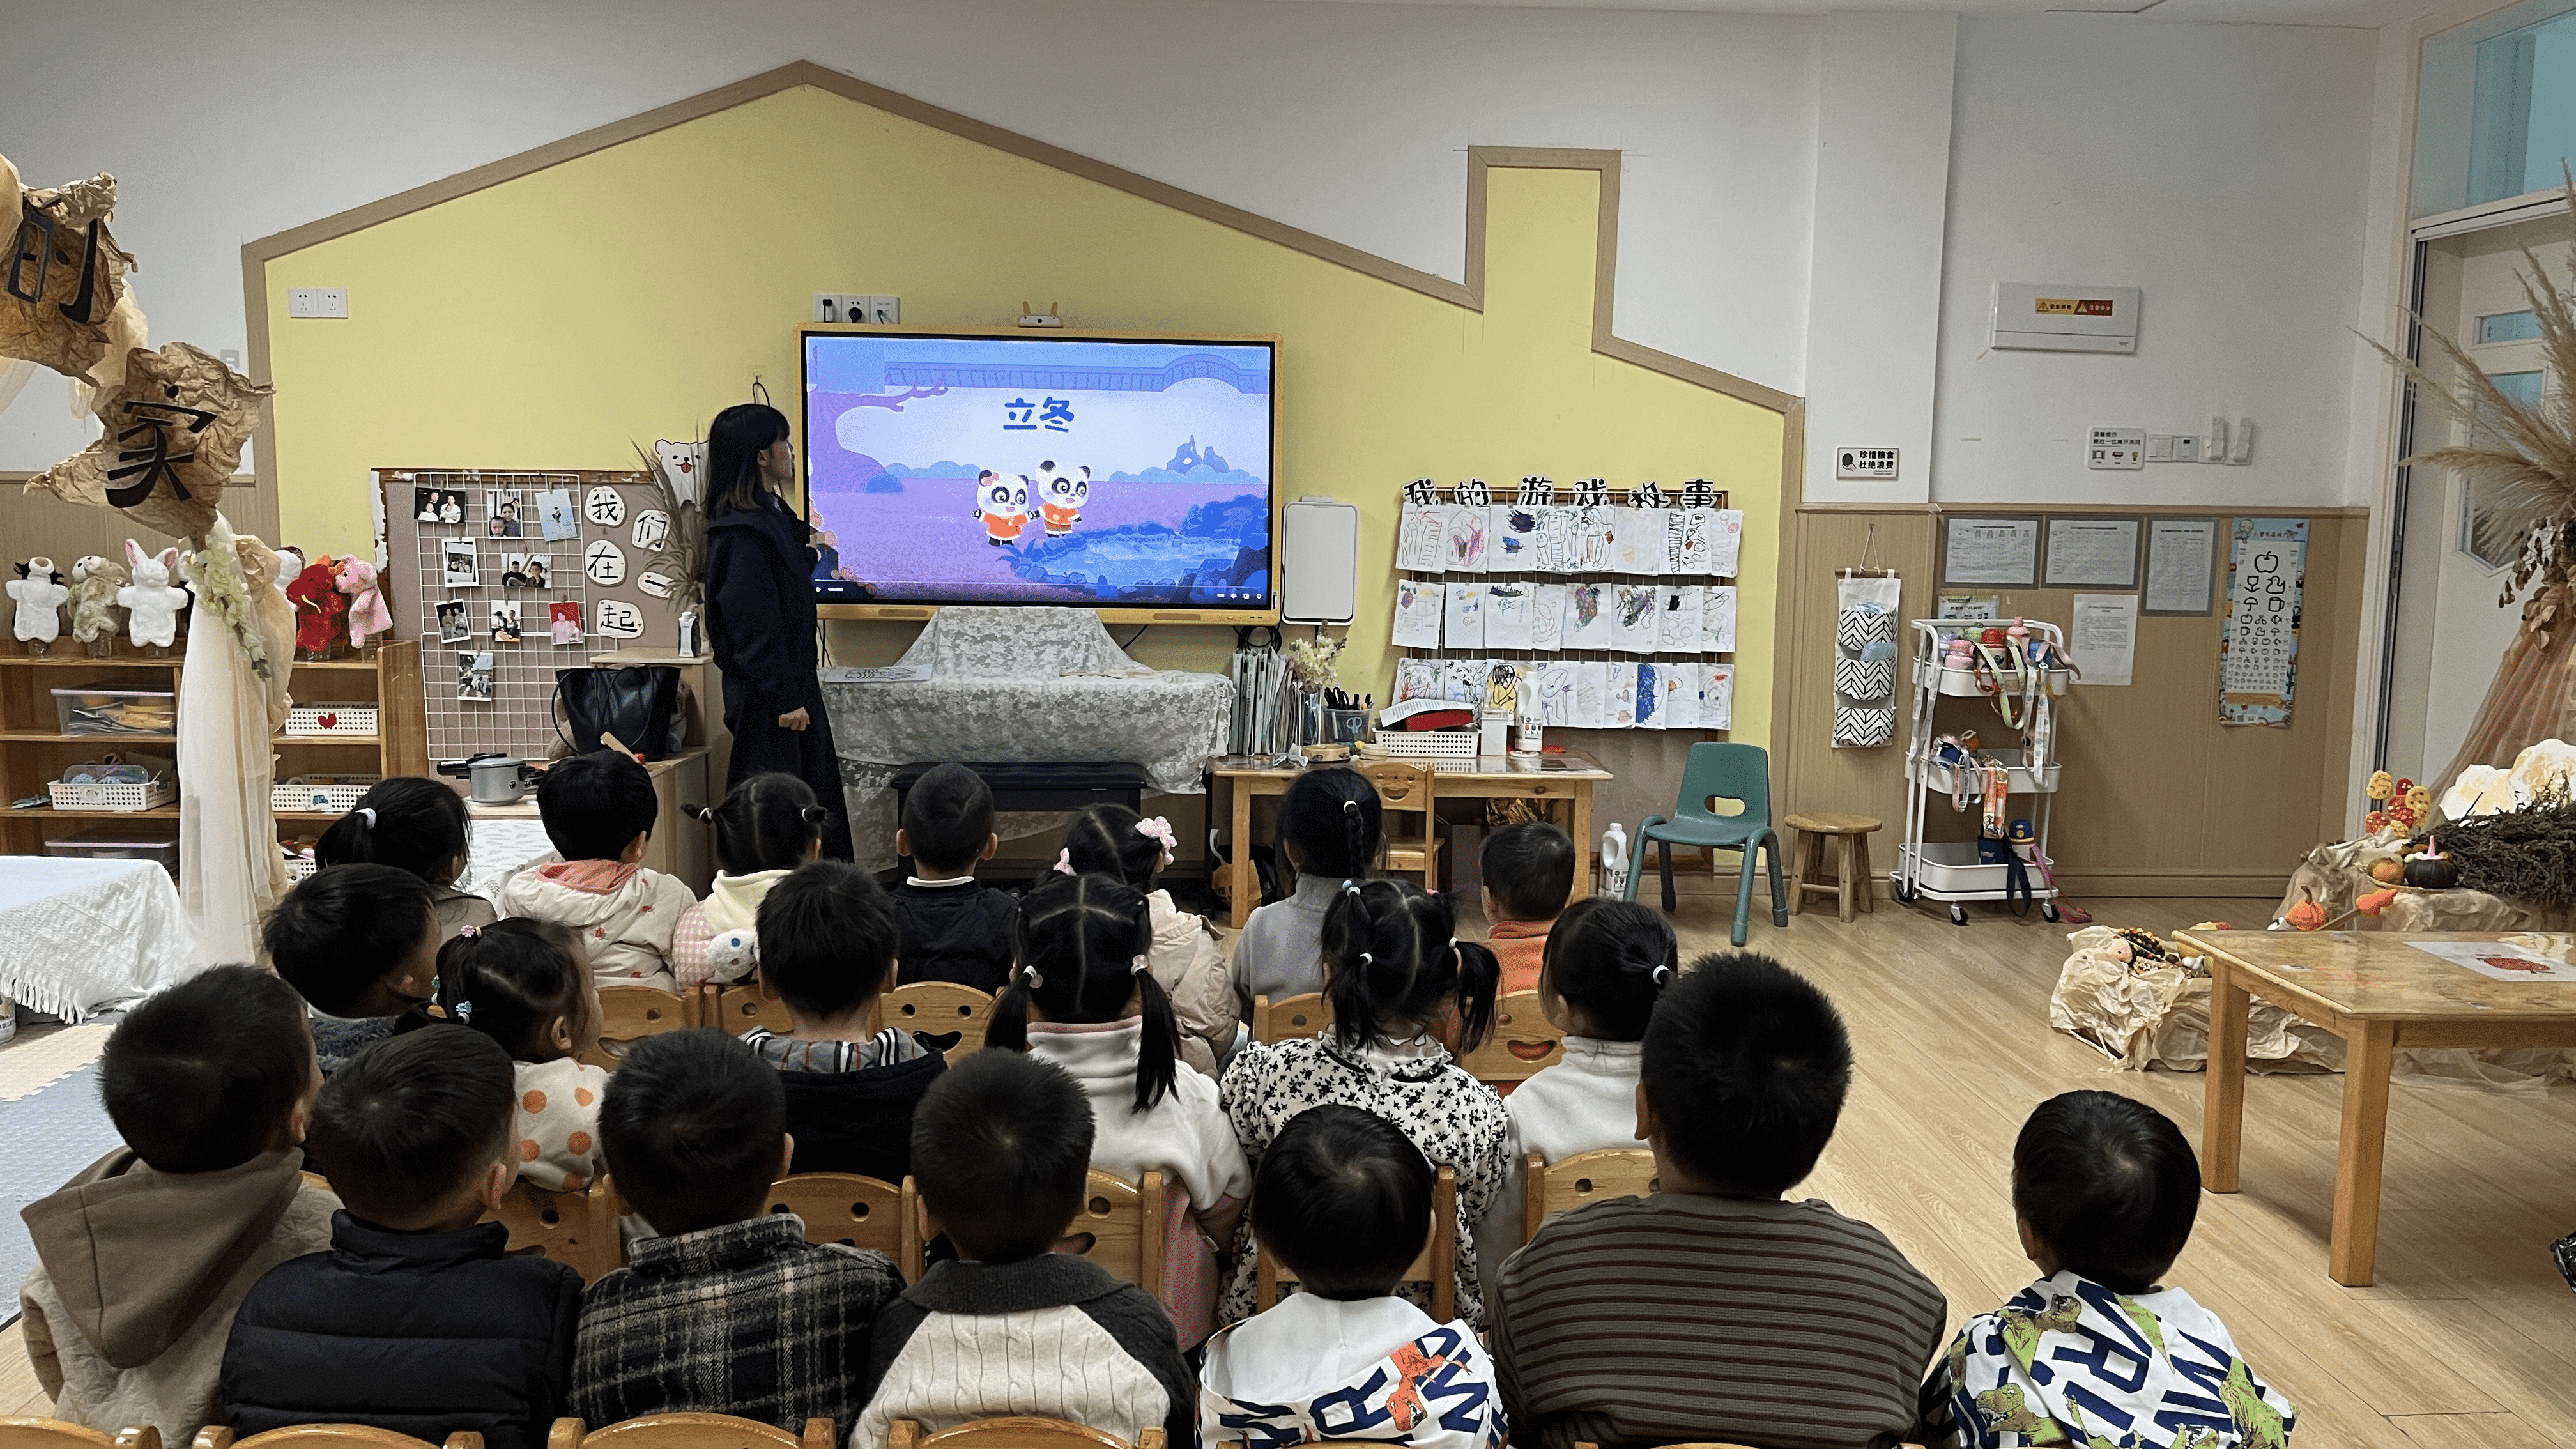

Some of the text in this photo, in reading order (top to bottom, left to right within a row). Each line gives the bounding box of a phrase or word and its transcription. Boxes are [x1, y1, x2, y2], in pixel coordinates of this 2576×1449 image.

[1002, 396, 1075, 433] 立冬
[105, 384, 217, 509] 家
[1859, 450, 1894, 459] 珍惜粮食
[1859, 461, 1894, 470] 杜绝浪费
[600, 604, 638, 634] 起
